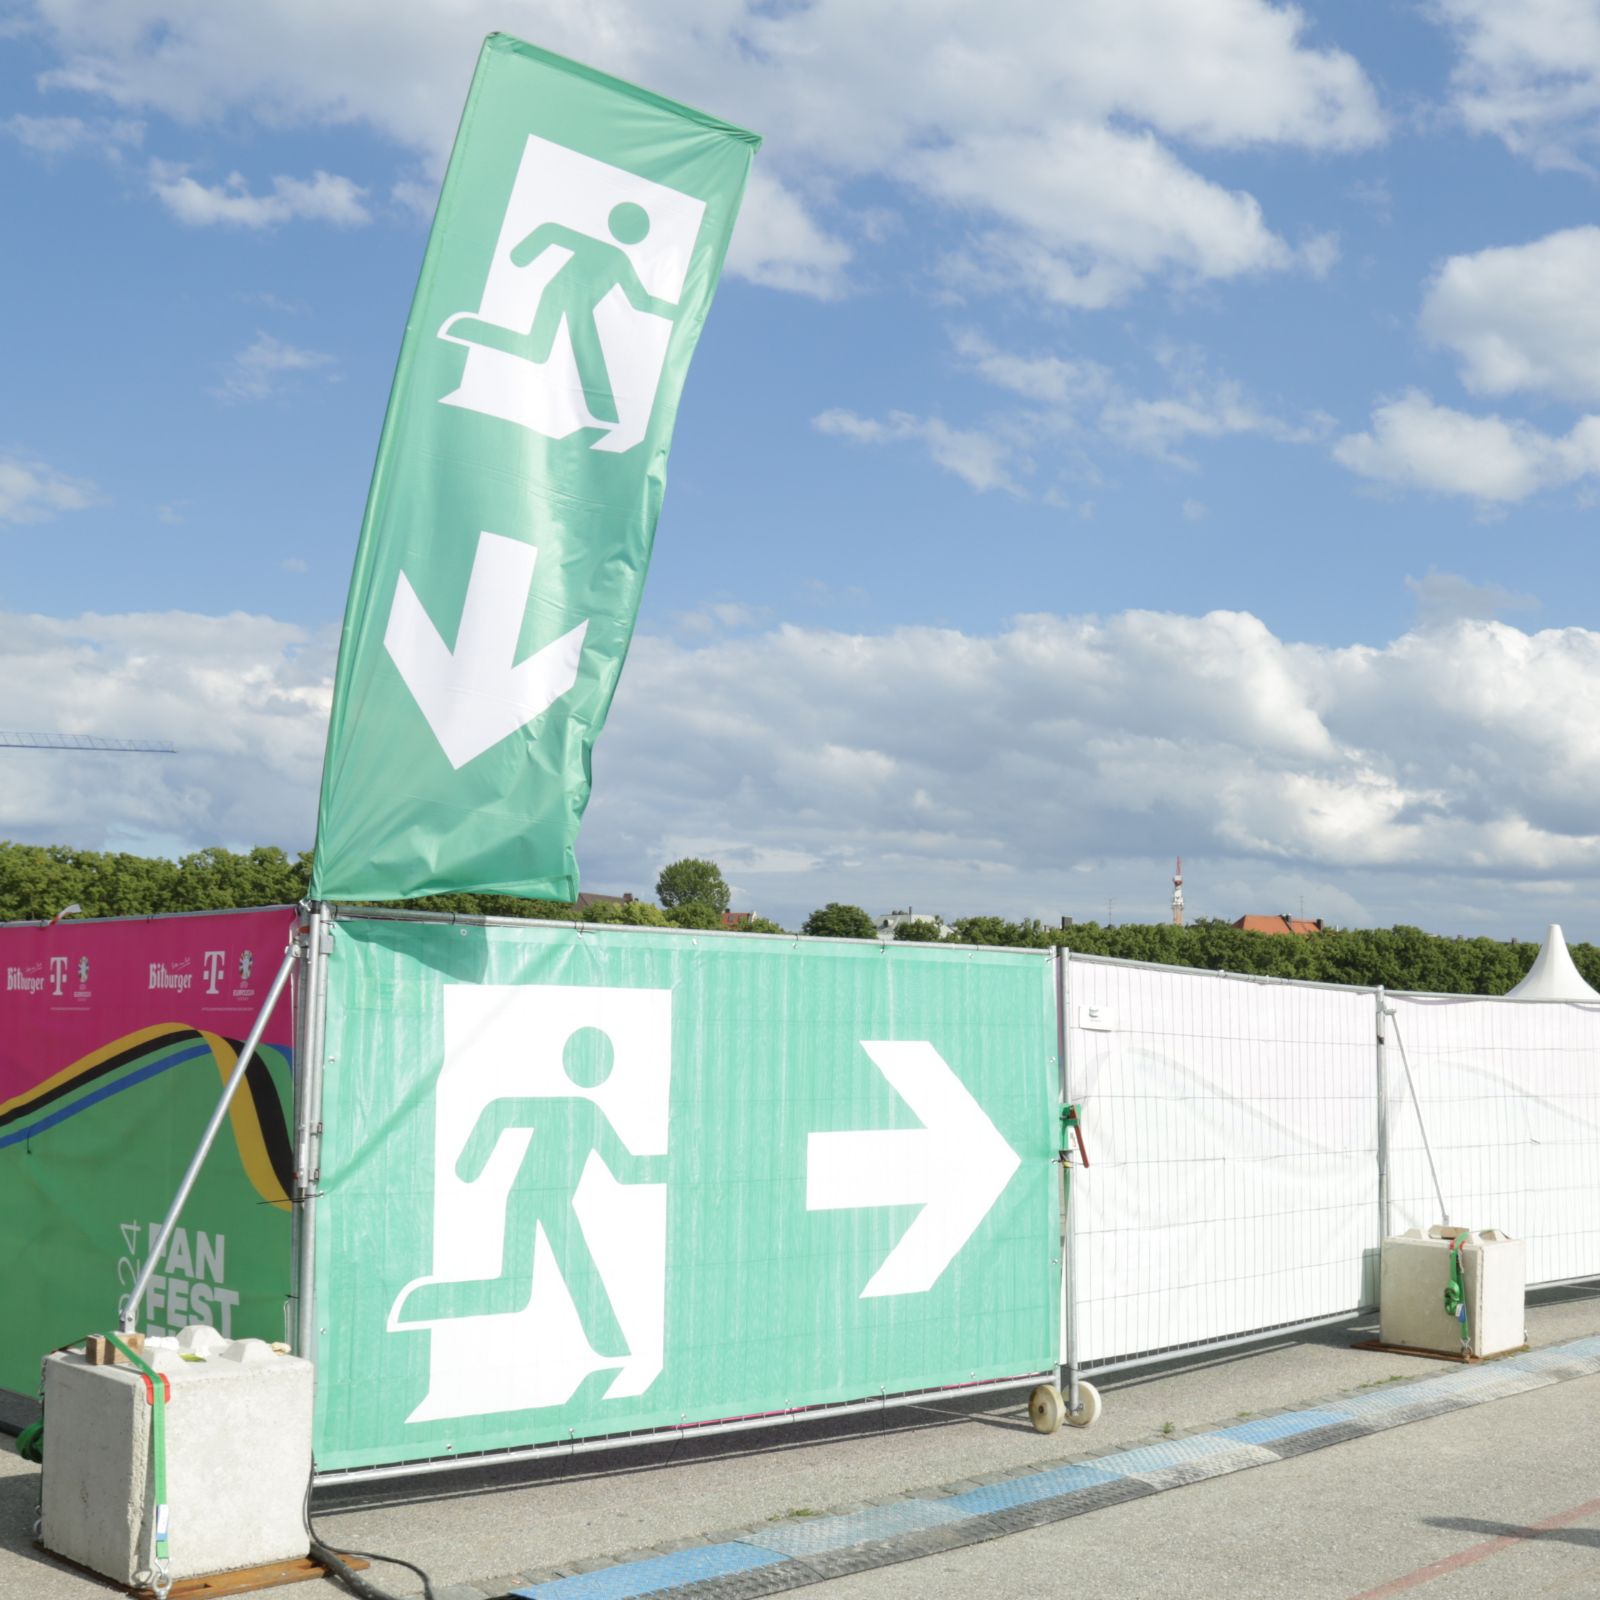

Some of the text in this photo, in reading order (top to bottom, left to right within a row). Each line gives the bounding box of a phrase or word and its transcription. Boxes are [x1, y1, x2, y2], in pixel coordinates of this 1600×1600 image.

[7, 967, 44, 995] Bitburger
[50, 957, 67, 996] T
[148, 962, 193, 994] Bitburger
[202, 950, 226, 994] T
[146, 1273, 240, 1339] FEST
